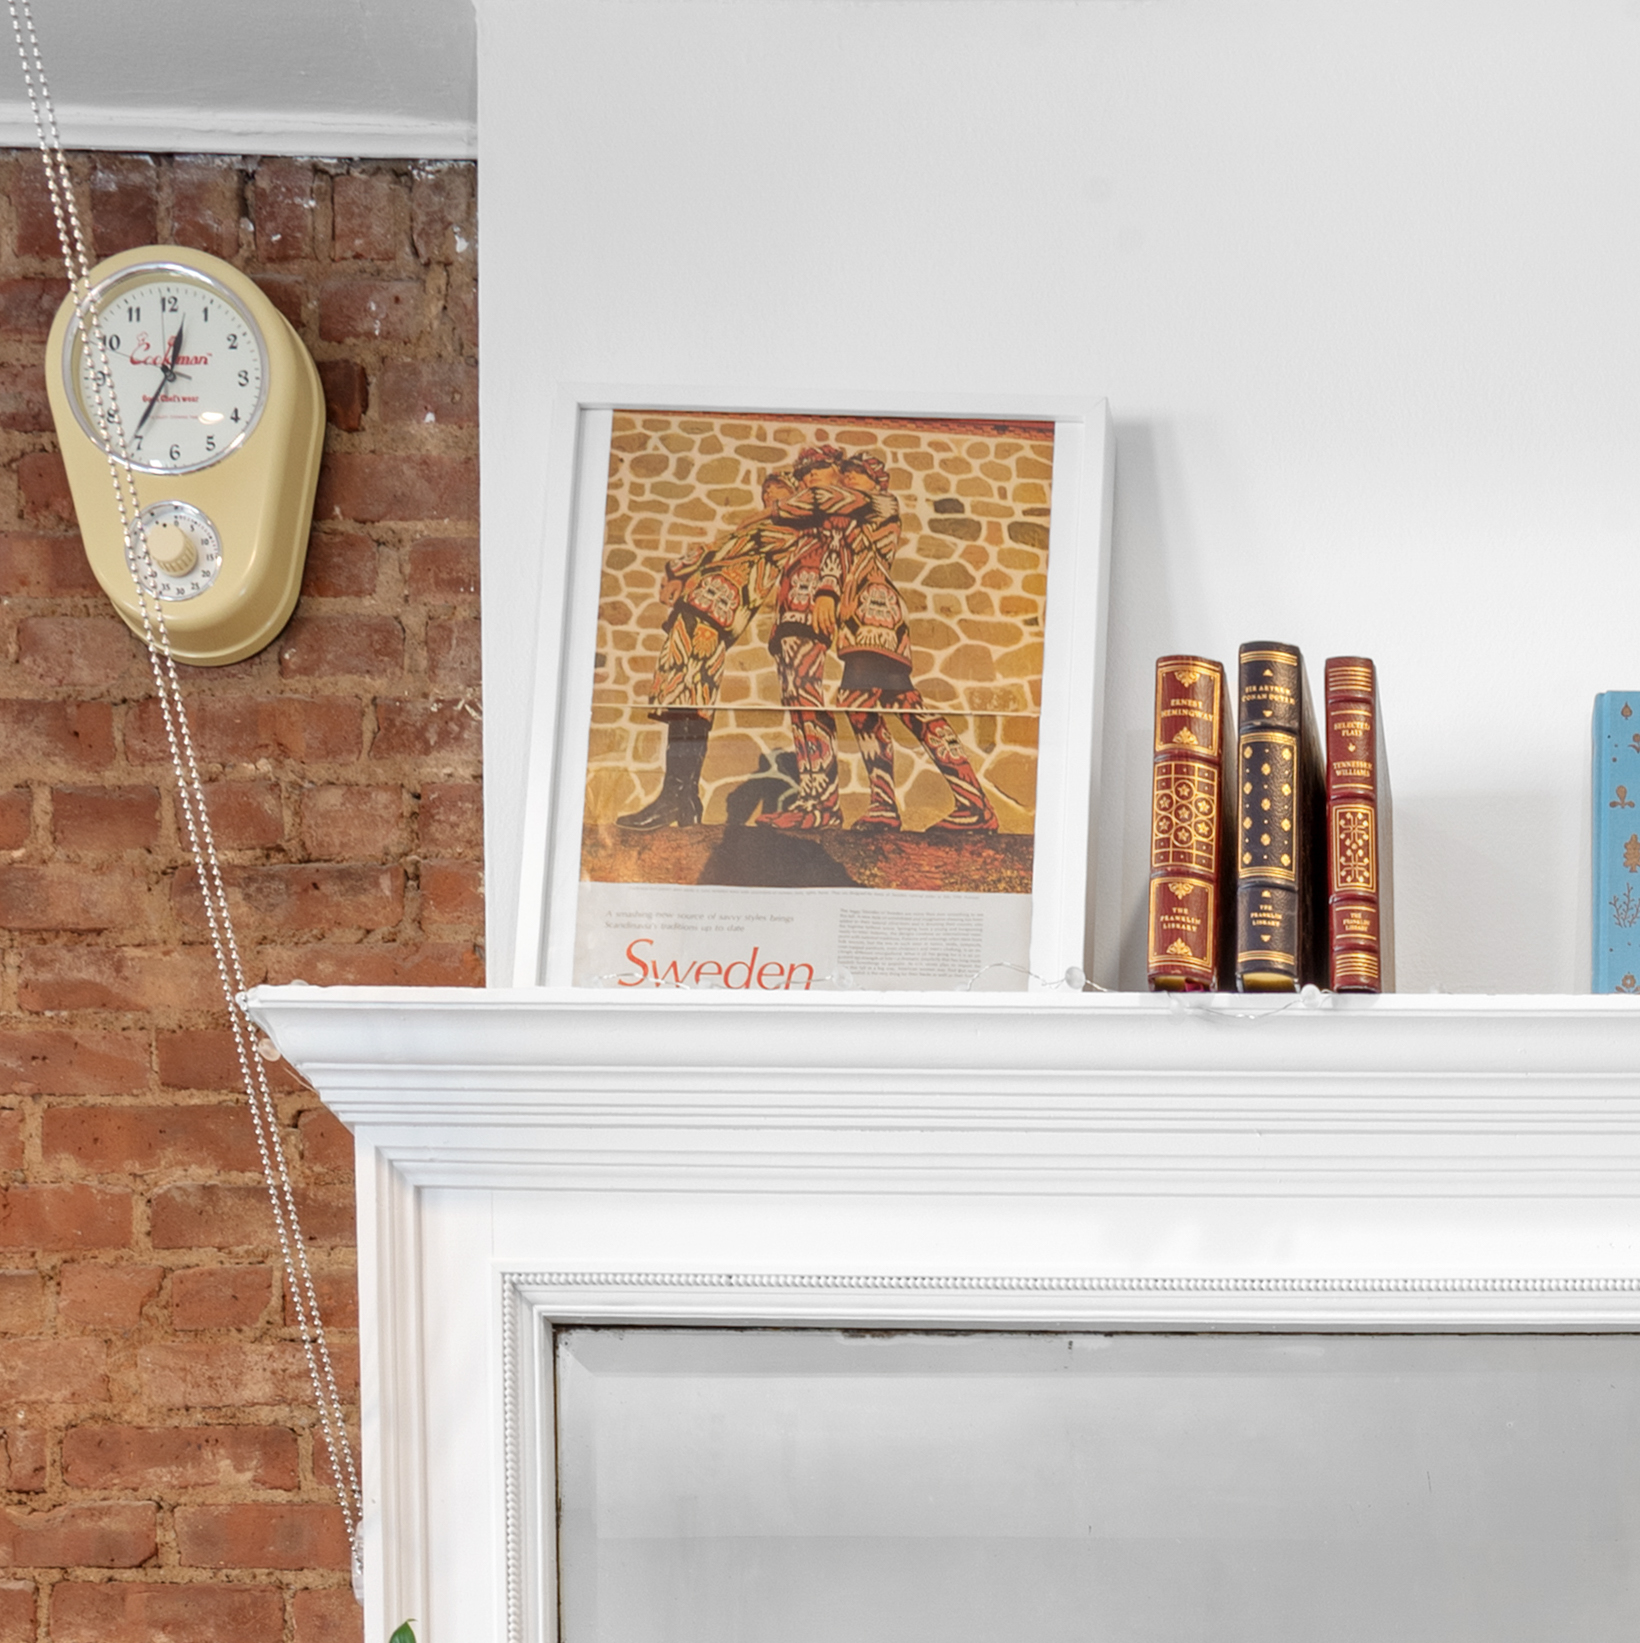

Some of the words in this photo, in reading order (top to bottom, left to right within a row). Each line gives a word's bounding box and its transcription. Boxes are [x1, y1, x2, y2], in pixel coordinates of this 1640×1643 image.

[161, 296, 178, 312] 12
[128, 307, 141, 322] 11
[227, 334, 239, 349] 2
[238, 370, 249, 386] 3
[230, 408, 240, 423] 4
[205, 436, 216, 451] 5
[1171, 699, 1203, 709] ERNEST
[1161, 710, 1214, 722] HEMINGWAY
[1334, 721, 1370, 731] SELECTED
[1342, 729, 1364, 737] PLAYS
[1333, 761, 1373, 770] TENNESSEE
[1336, 769, 1371, 777] WILLIAMS
[1172, 906, 1189, 914] THE
[1160, 914, 1201, 925] FRANKLIN
[1163, 922, 1198, 932] LIBRARY
[617, 937, 814, 990] Sweden
